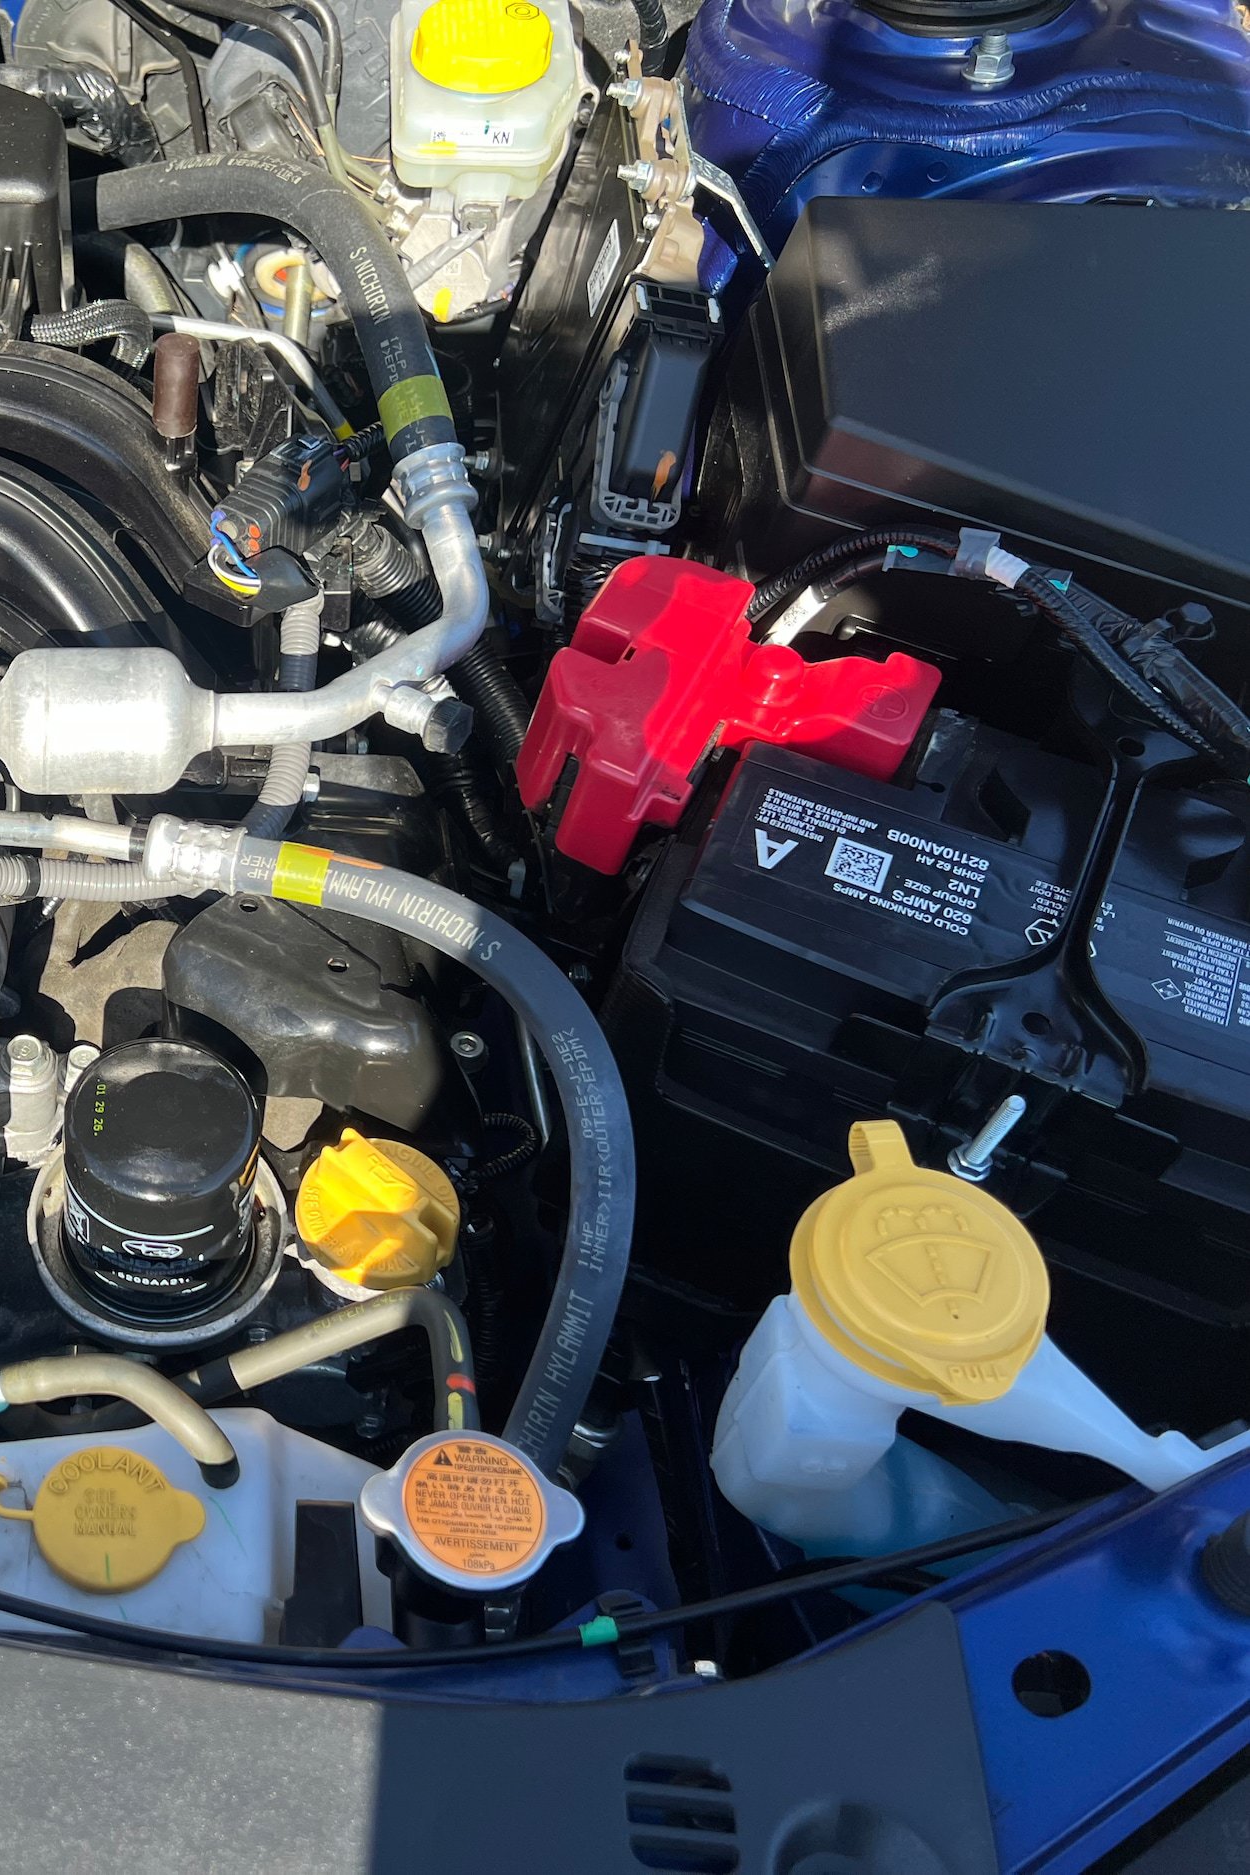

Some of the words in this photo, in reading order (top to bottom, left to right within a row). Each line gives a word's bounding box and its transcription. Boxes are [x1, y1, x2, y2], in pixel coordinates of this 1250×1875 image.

[492, 131, 510, 144] KN
[767, 786, 815, 810] MATERIALS
[779, 798, 803, 812] WITH
[754, 812, 769, 823] BY:
[787, 808, 800, 819] WI
[814, 802, 858, 824] IMPORTED
[829, 816, 840, 825] IN
[839, 819, 865, 834] MADE
[858, 817, 877, 830] AND
[768, 817, 824, 843] DISTRIBUTED
[754, 828, 799, 870] A
[886, 827, 989, 872] 82110AN00B
[915, 853, 935, 866] AH
[935, 859, 952, 871] 62
[952, 865, 985, 882] 20HR
[832, 881, 867, 900] AMPS
[903, 878, 931, 894] SIZE
[946, 878, 981, 898] LN2
[1027, 884, 1051, 897] DOIT
[890, 888, 941, 914] AMPS
[931, 887, 977, 909] GROUP
[867, 894, 932, 923] CRANKING
[941, 905, 972, 925] 620
[1030, 902, 1058, 916] MUST
[933, 917, 968, 935] COLD
[1186, 949, 1198, 958] UN
[1176, 961, 1194, 973] YEUX
[1197, 952, 1236, 970] CONSULTEZ
[1194, 967, 1208, 977] LES
[1208, 972, 1232, 985] RINCEZ
[1182, 980, 1215, 996] MEDICAL
[1212, 982, 1231, 994] HELP
[1209, 997, 1227, 1009] WITH
[1215, 991, 1229, 1001] GET
[1180, 995, 1226, 1016] IMMEDIATELY
[1183, 1005, 1201, 1016] EYES
[1201, 1011, 1224, 1024] FLUSH
[94, 1100, 104, 1113] 29
[542, 1287, 593, 1388] HYLAMMIT
[949, 1363, 1011, 1383] PULL
[453, 1454, 508, 1466] WARNING
[49, 1451, 166, 1495] COOLANT
[415, 1489, 445, 1498] NEVER
[449, 1492, 474, 1501] OPEN
[478, 1494, 506, 1503] WHEN
[415, 1498, 425, 1506] NE
[429, 1499, 457, 1508] JAMAIS
[460, 1502, 490, 1511] OUVRIR
[74, 1521, 137, 1537] MANUAL
[433, 1536, 518, 1552] AVERTISSEMENT
[461, 1558, 495, 1570] 108kPa
